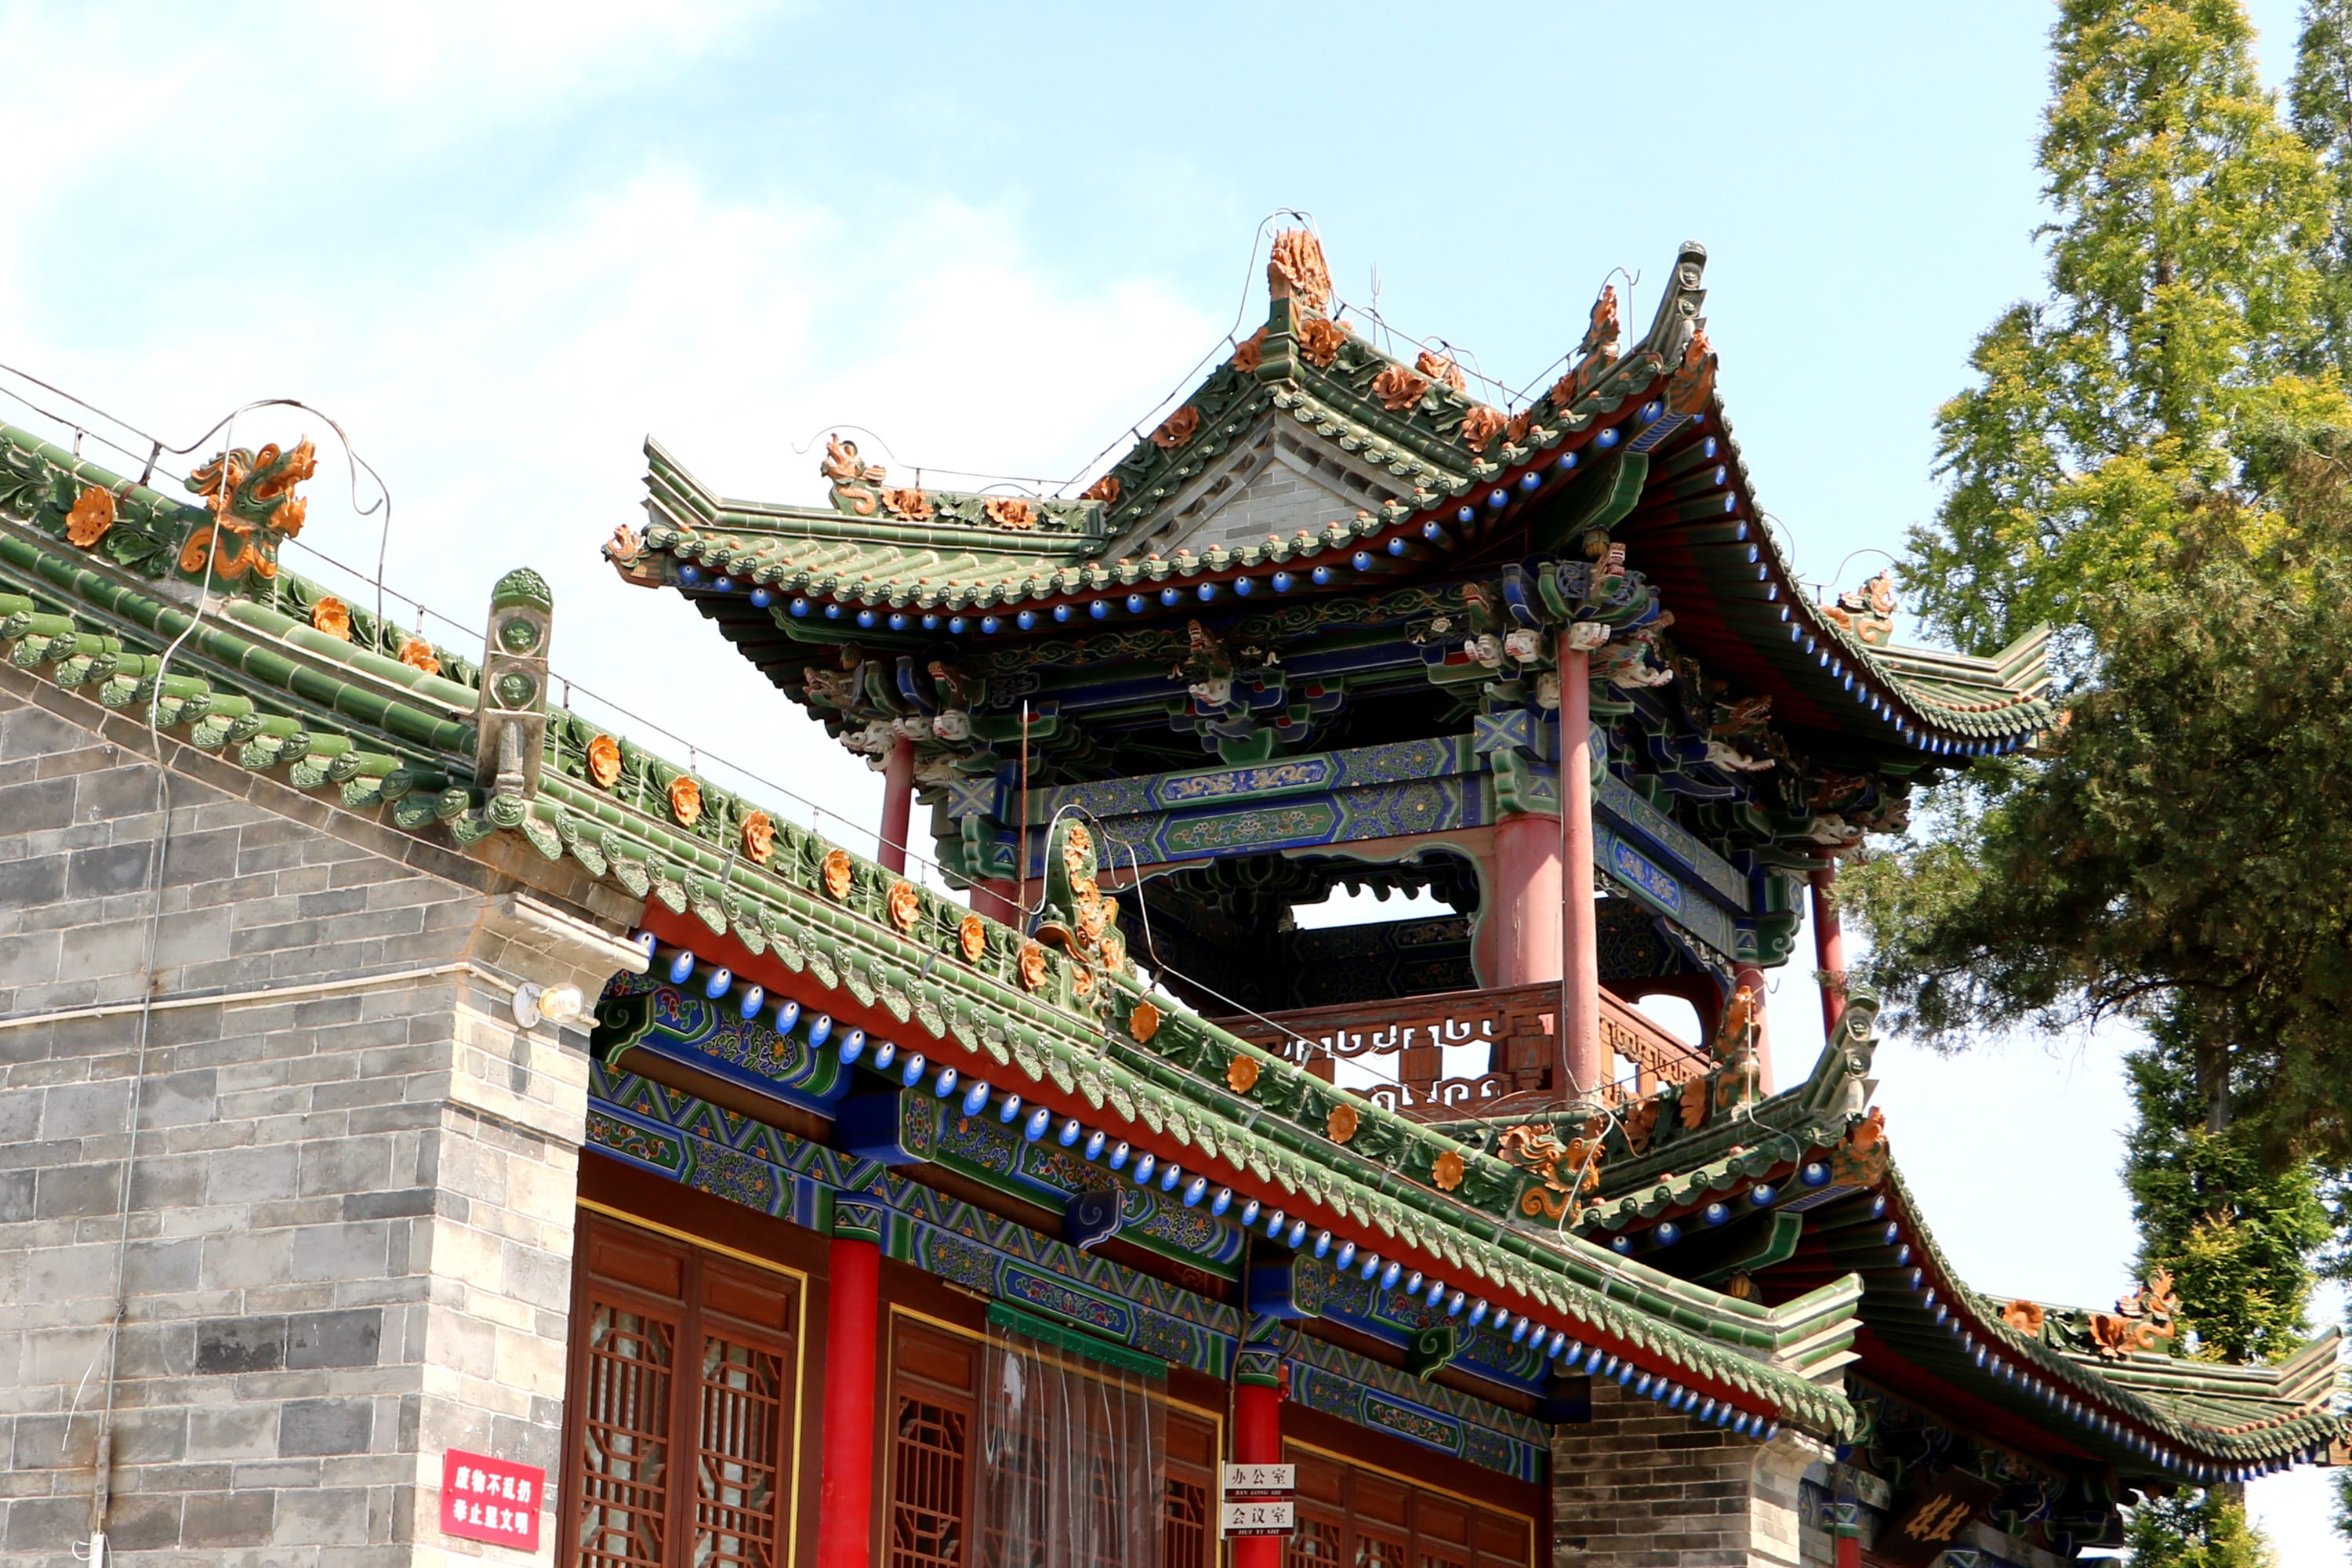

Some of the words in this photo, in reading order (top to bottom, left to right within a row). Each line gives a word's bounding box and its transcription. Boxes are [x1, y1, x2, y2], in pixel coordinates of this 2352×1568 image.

[455, 1466, 532, 1503] 废物不乱扔
[1232, 1468, 1286, 1484] 办公室
[453, 1499, 528, 1534] 举止显文明
[1232, 1507, 1286, 1524] 会议室
